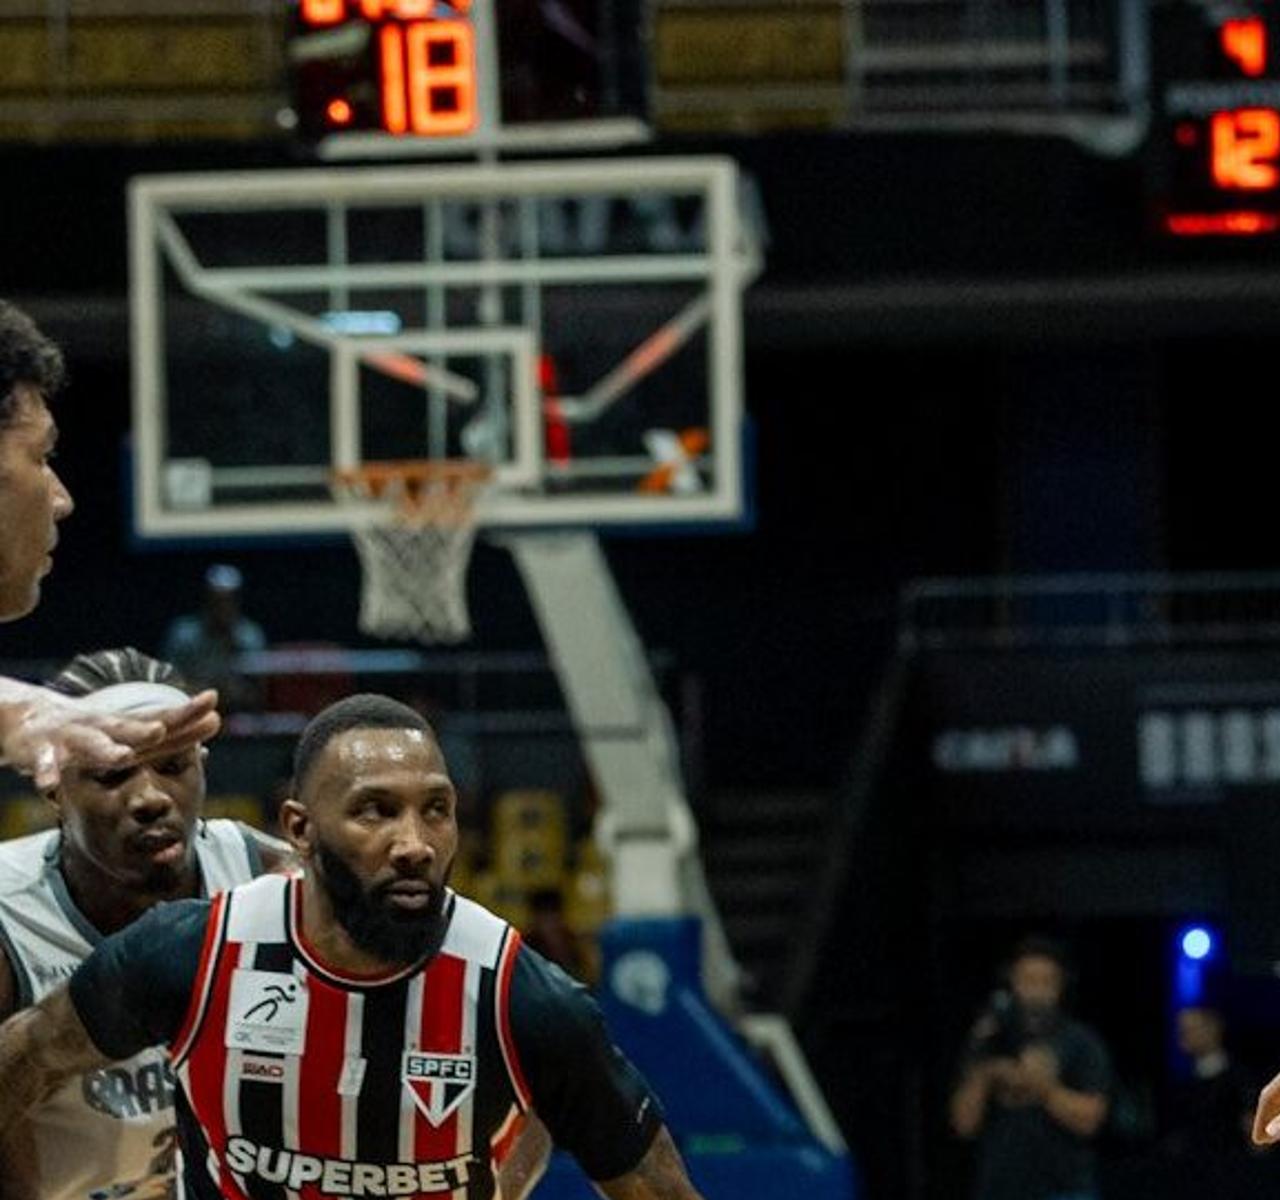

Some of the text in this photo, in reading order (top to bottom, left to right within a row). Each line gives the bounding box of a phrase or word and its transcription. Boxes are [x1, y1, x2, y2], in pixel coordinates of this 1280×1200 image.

[380, 20, 479, 135] 18
[408, 1057, 472, 1080] SPFC
[225, 1136, 476, 1198] SUPERBET
